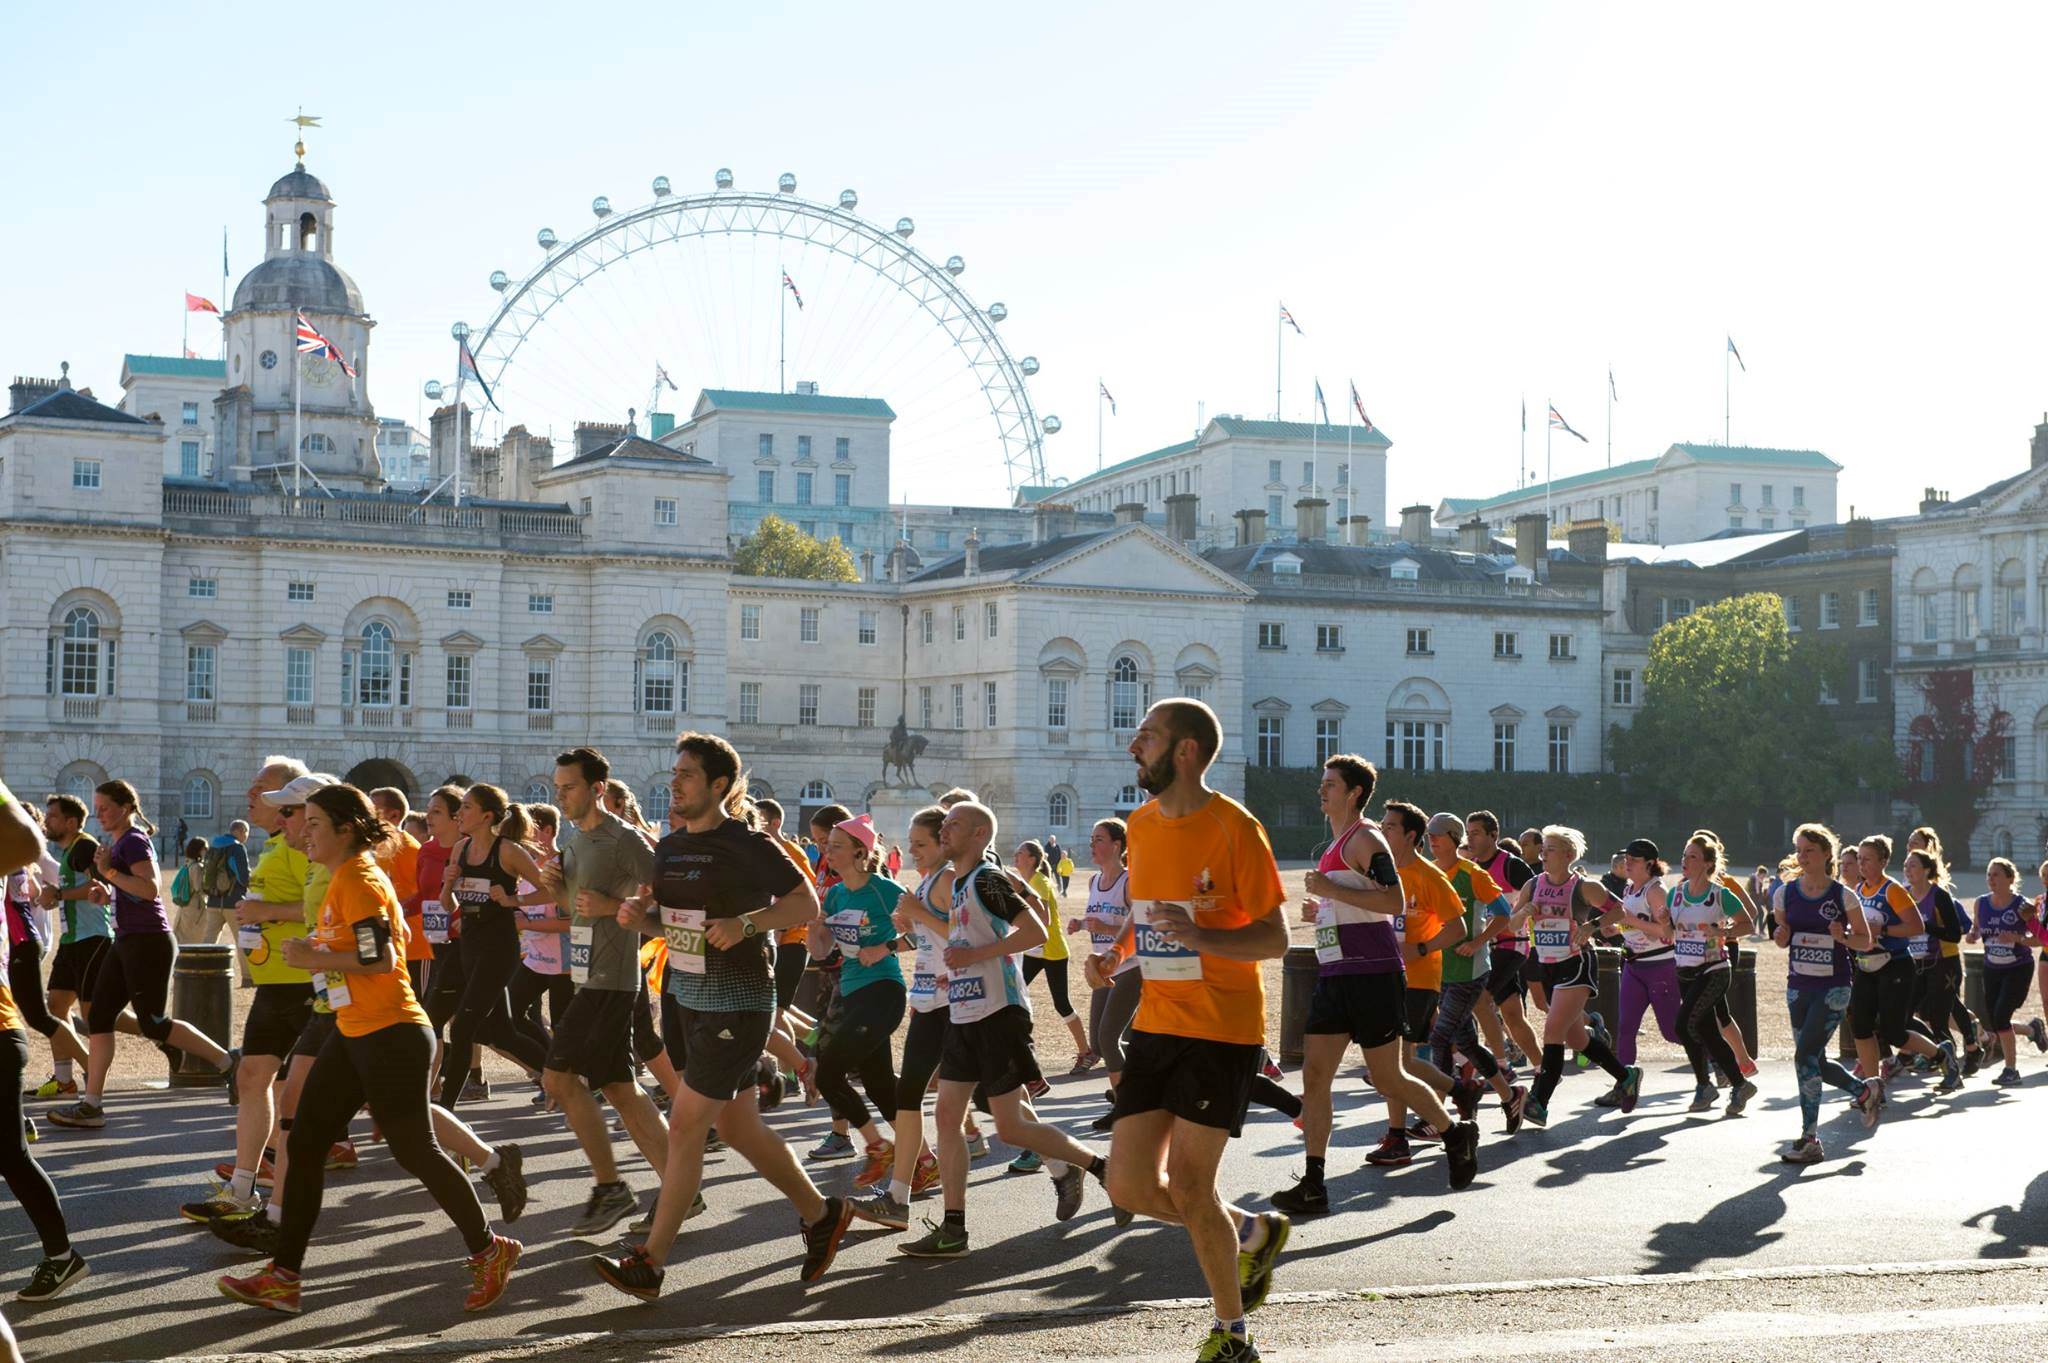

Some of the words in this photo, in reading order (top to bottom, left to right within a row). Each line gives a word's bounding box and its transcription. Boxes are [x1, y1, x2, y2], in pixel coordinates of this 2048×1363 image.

[1539, 888, 1564, 898] LULA
[664, 927, 702, 953] 8297
[1136, 930, 1194, 952] 1629
[1535, 933, 1569, 945] 12617
[1677, 941, 1705, 955] 13585
[1793, 948, 1832, 962] 12326
[950, 981, 982, 999] 13624
